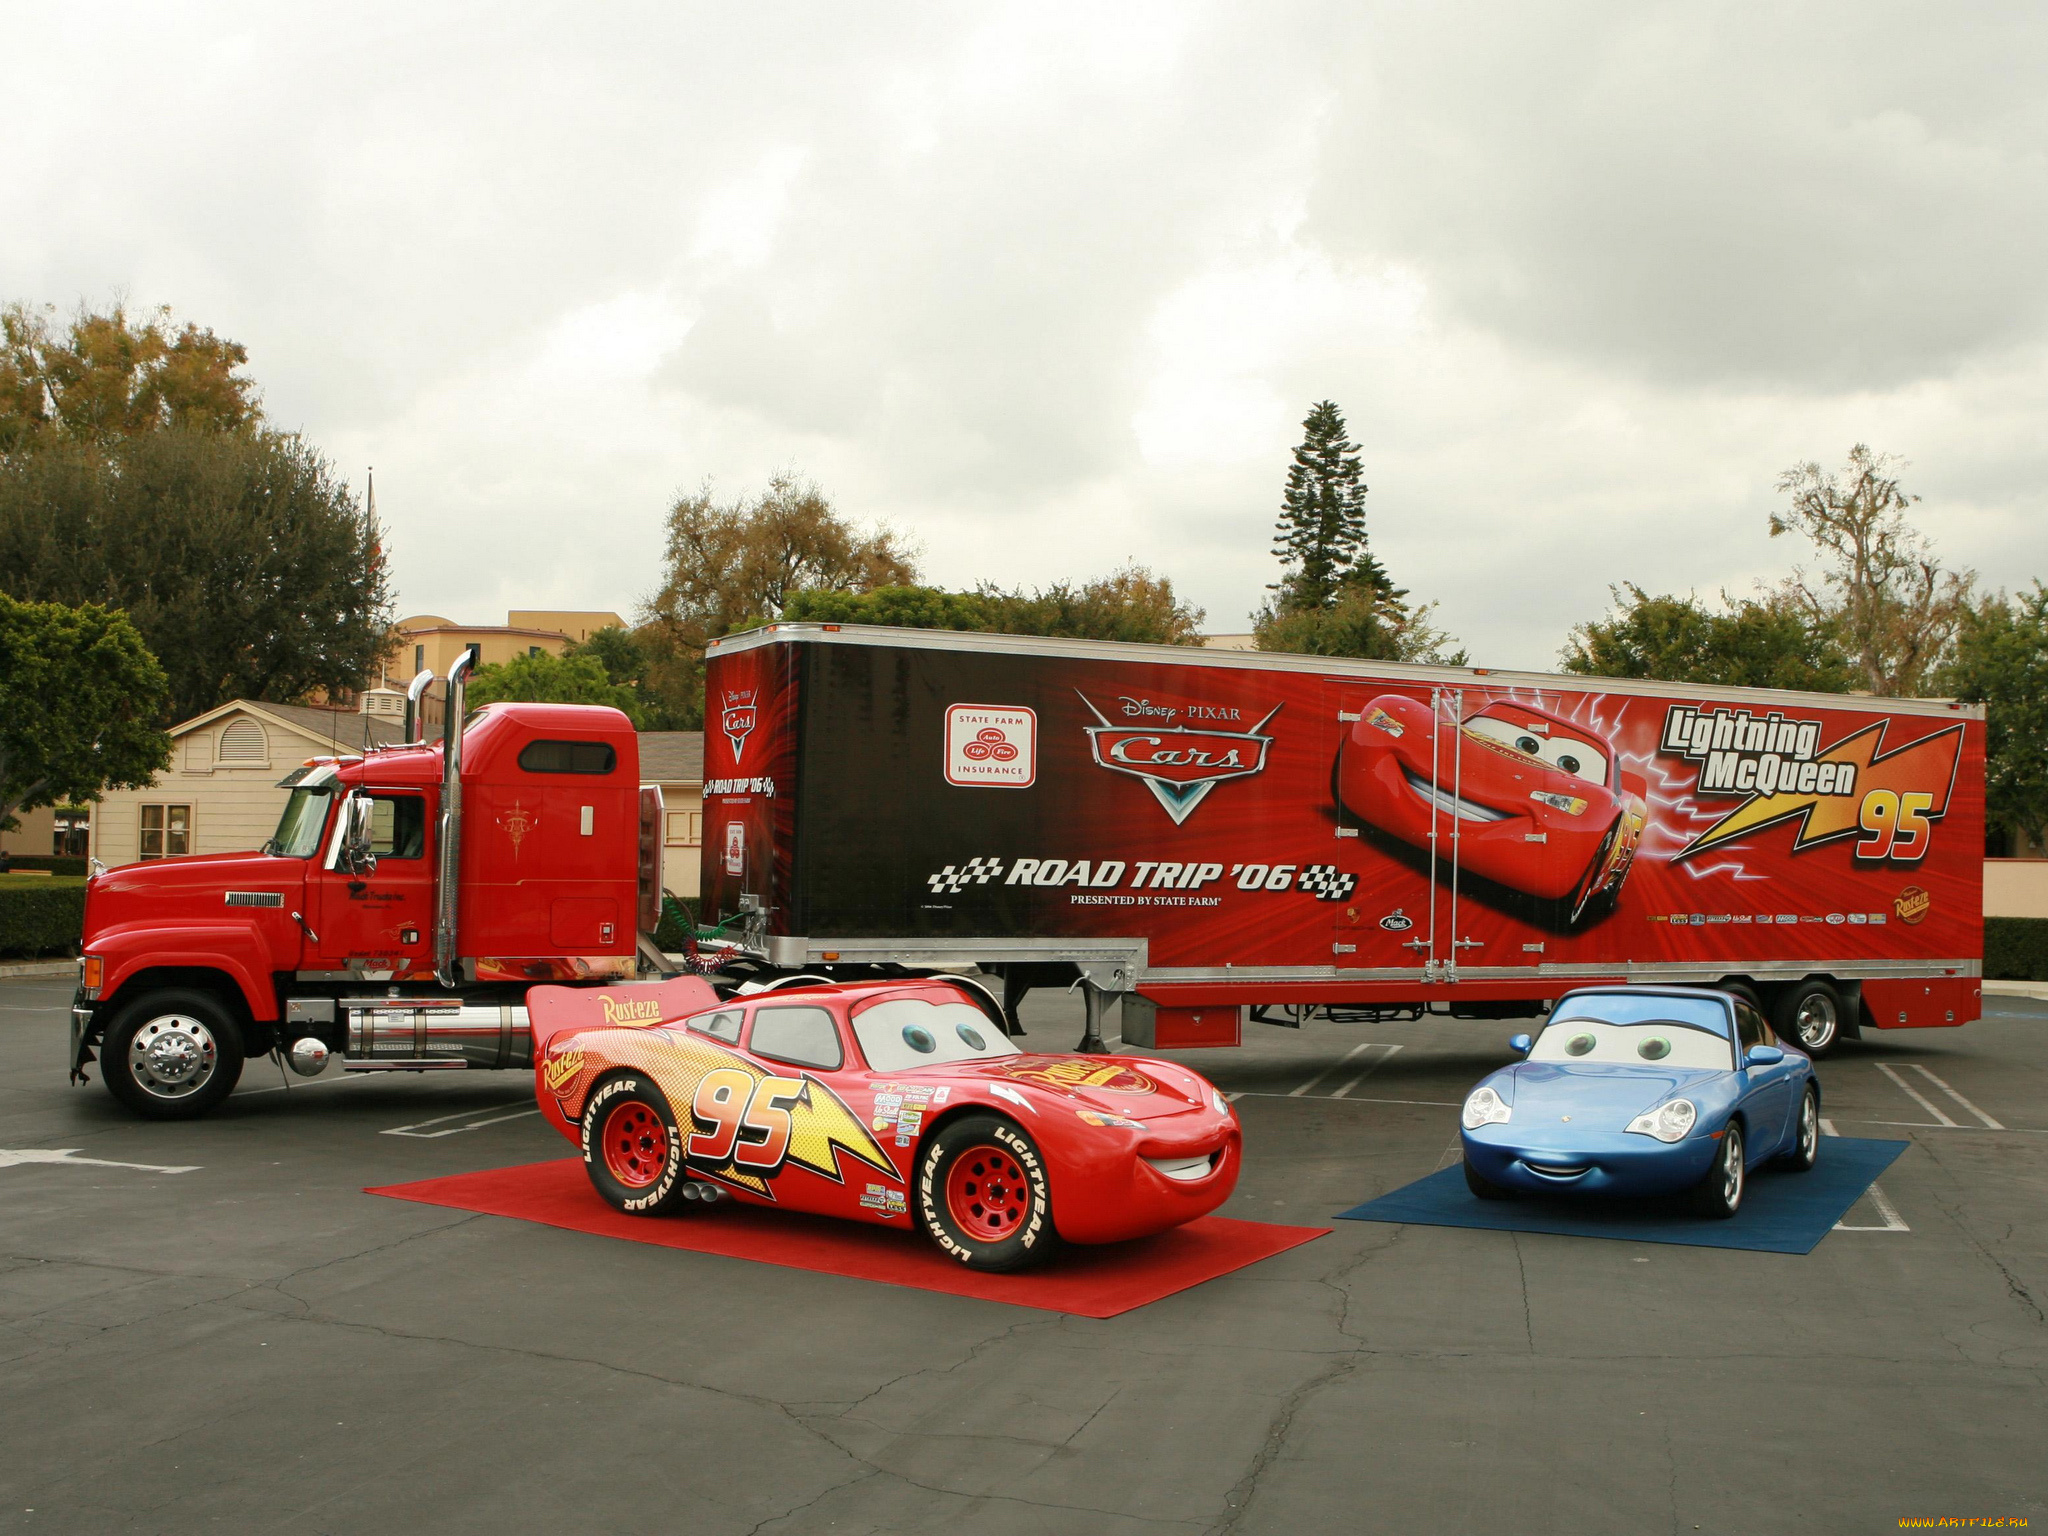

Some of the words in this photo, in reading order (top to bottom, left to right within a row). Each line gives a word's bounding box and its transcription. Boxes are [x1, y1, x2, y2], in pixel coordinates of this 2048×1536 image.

[725, 713, 751, 730] Cars
[959, 715, 989, 724] STATE
[995, 717, 1023, 725] FARM
[1187, 705, 1241, 721] PIXAR
[1666, 709, 1819, 760] Lightning
[970, 747, 986, 756] Life
[1110, 736, 1245, 769] Cars
[713, 779, 733, 794] ROAD
[733, 778, 749, 793] TRIP
[750, 777, 764, 793] '06
[958, 765, 1023, 775] INSURANCE
[1702, 751, 1856, 796] McQueen
[1855, 788, 1934, 861] 95
[1004, 858, 1126, 887] ROAD
[1130, 861, 1224, 889] TRIP
[1229, 863, 1297, 890] '06
[1070, 895, 1135, 905] PRESENTED
[1137, 896, 1152, 905] BY
[1153, 896, 1187, 906] STATE
[876, 1094, 901, 1104] MOOD
[582, 1080, 637, 1163] LIGHTYEAR
[687, 1068, 807, 1168] 95
[623, 1126, 680, 1211] LIGHTYEAR
[921, 1143, 972, 1262] LIGHTYEAR
[993, 1126, 1046, 1249] LIGHTYEAR
